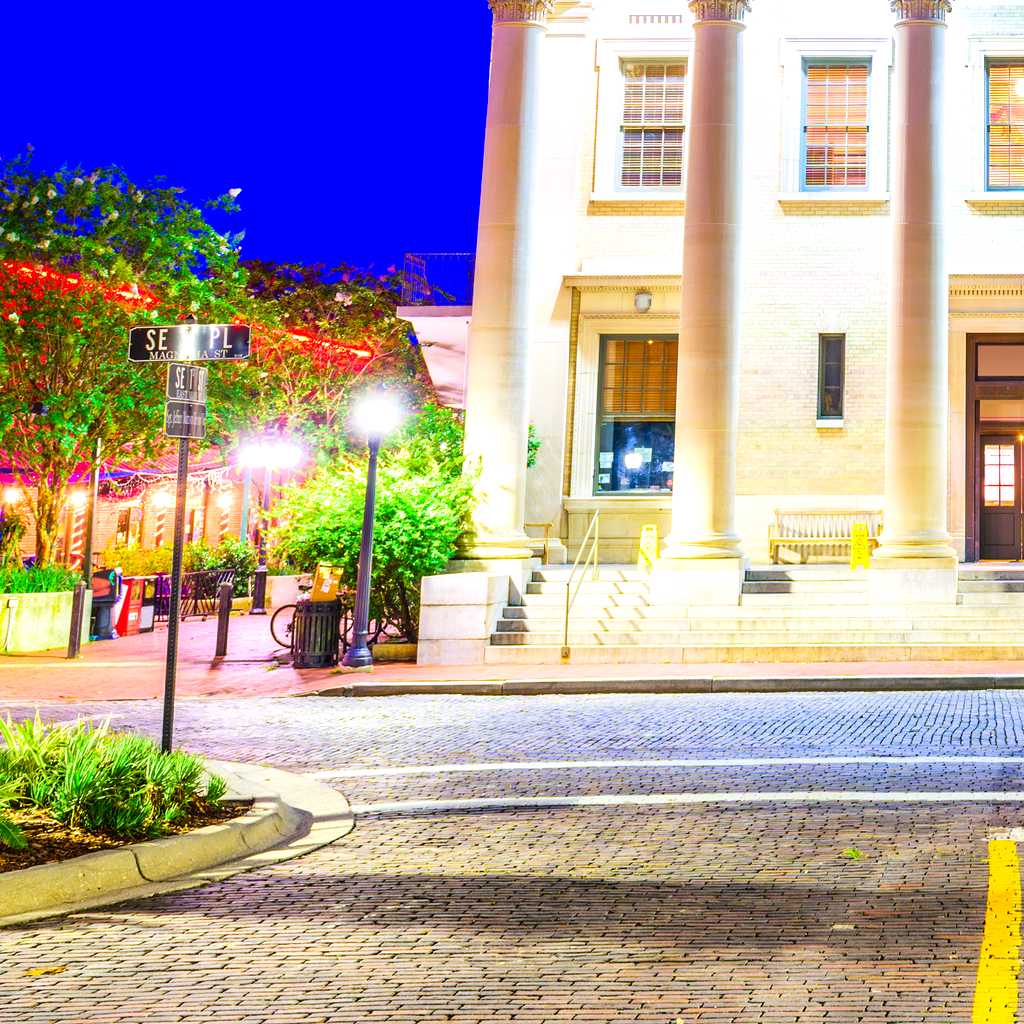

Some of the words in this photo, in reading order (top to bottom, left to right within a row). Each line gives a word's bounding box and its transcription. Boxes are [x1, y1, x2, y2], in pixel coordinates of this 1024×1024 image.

[145, 328, 169, 351] SE
[209, 326, 233, 349] PL
[149, 350, 208, 361] MAGIA
[214, 349, 229, 358] ST
[175, 366, 186, 389] SE
